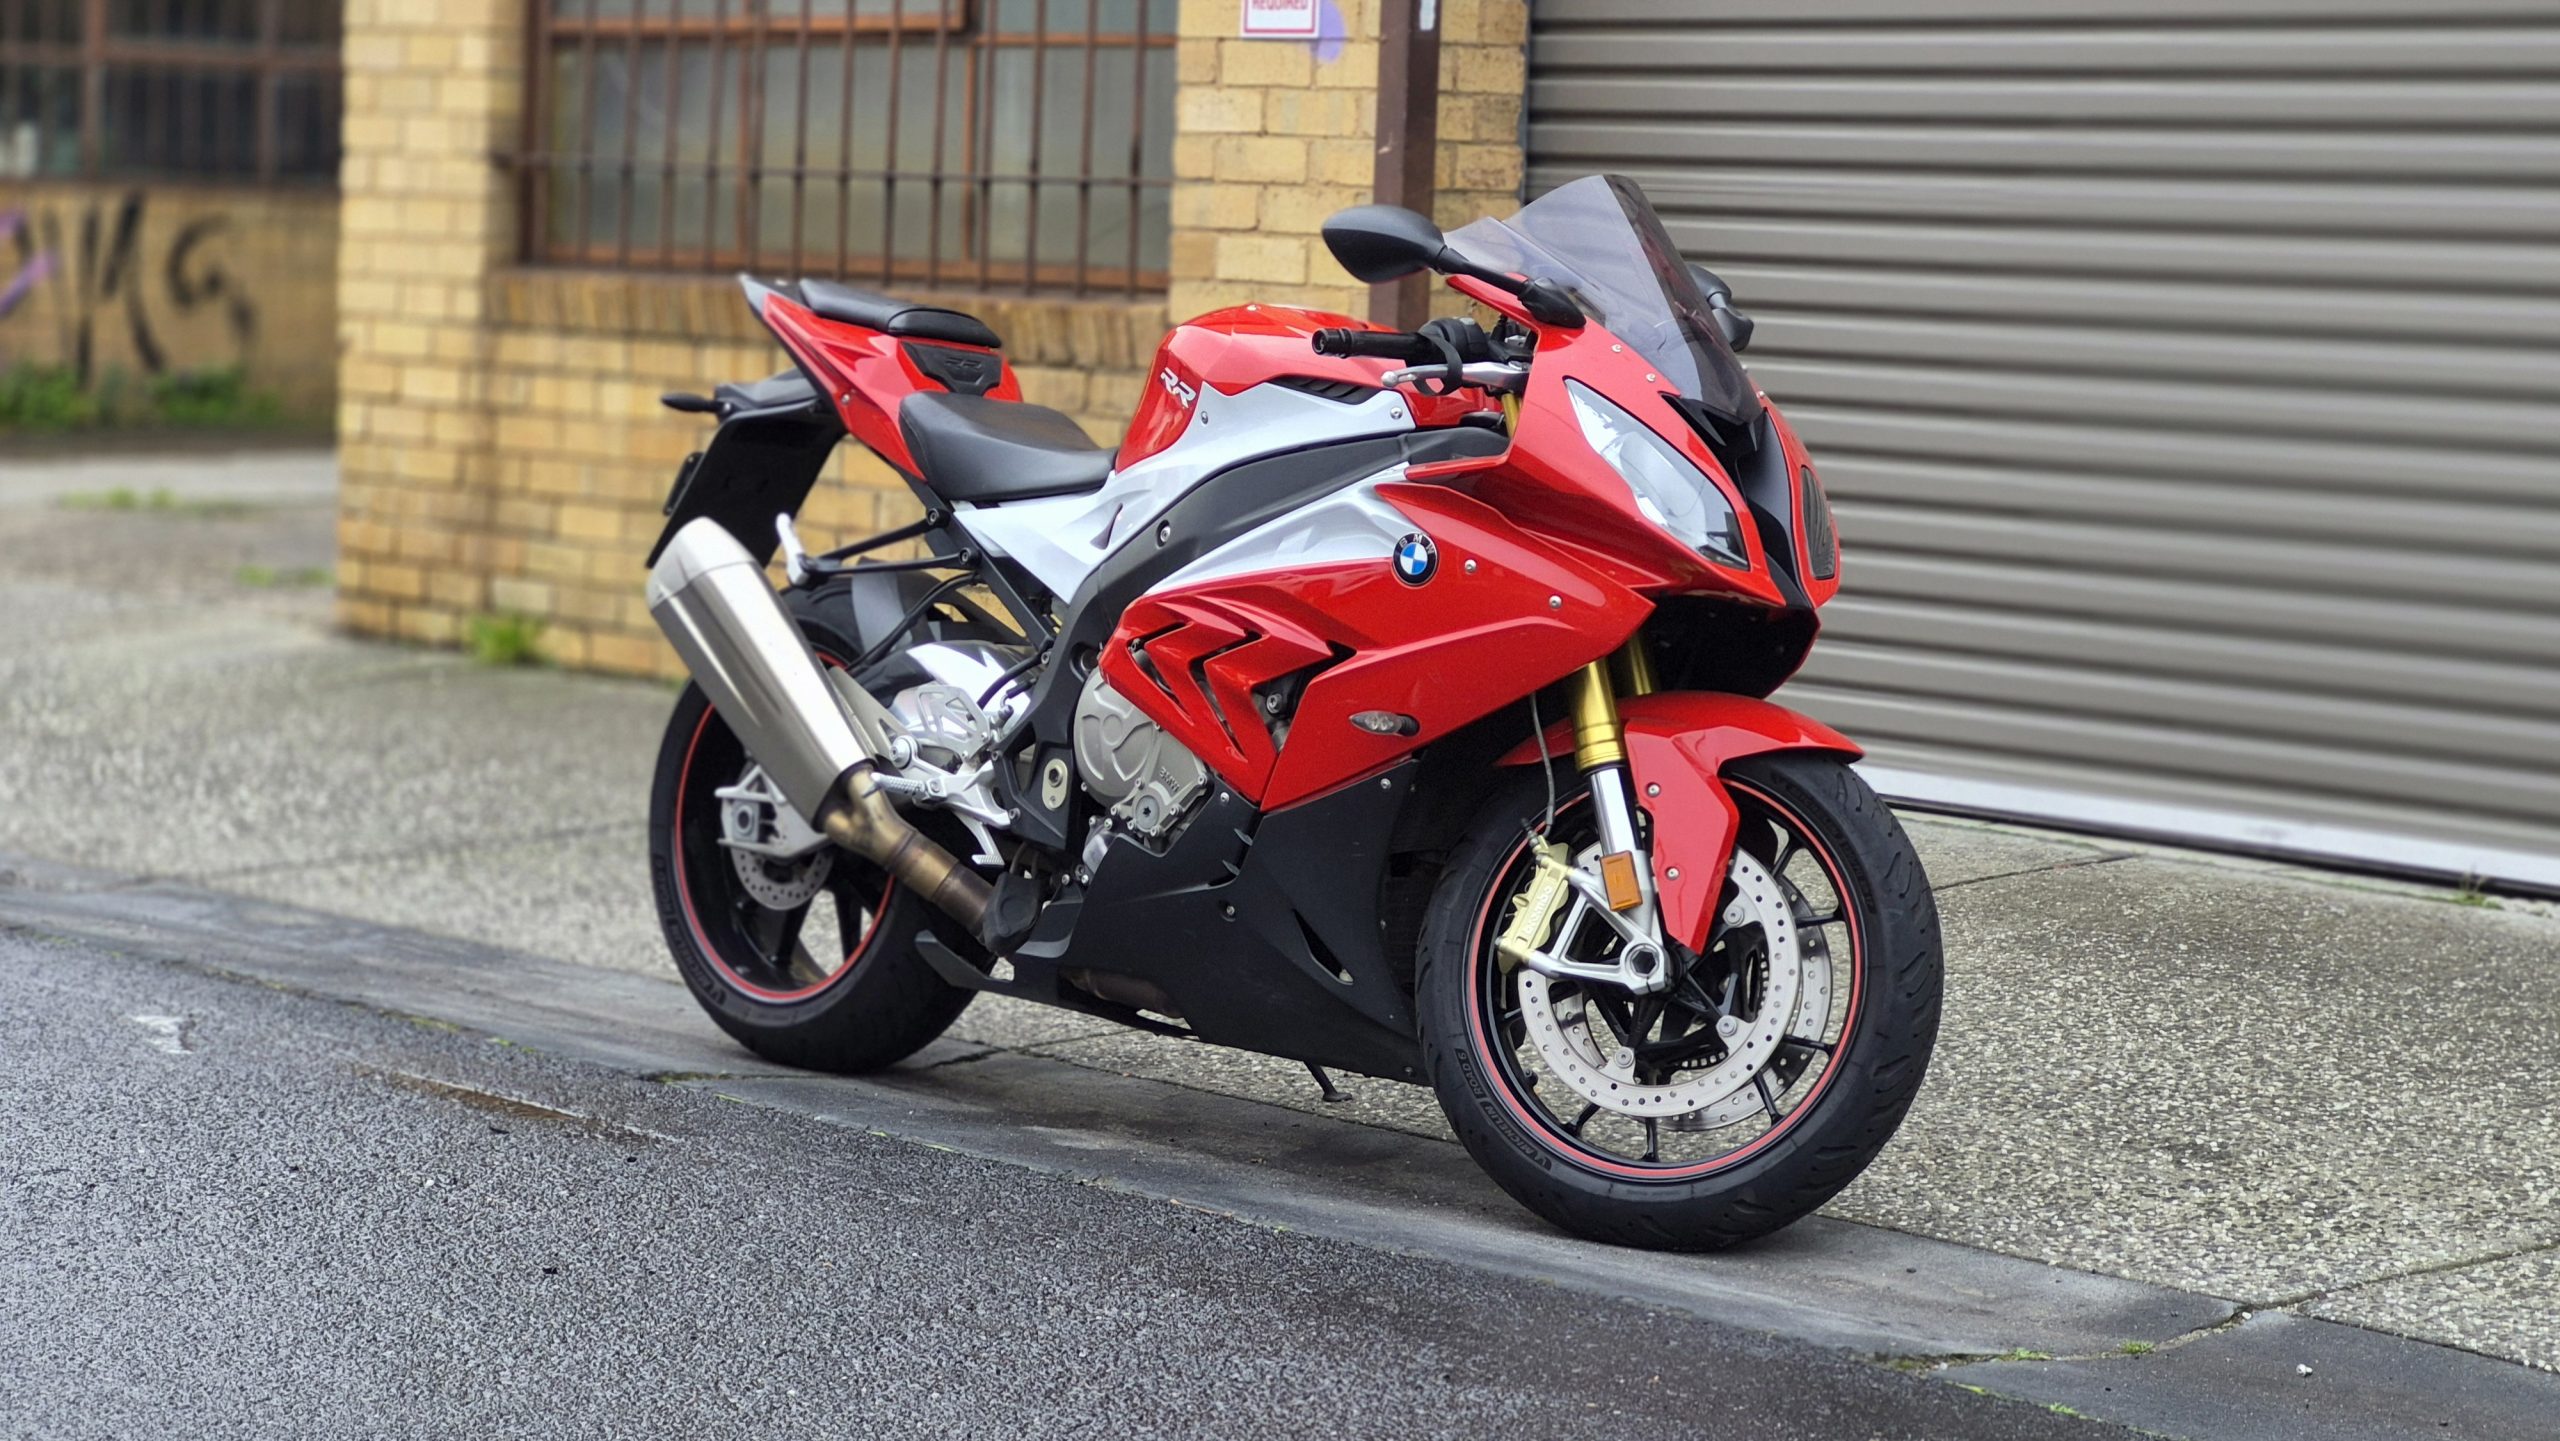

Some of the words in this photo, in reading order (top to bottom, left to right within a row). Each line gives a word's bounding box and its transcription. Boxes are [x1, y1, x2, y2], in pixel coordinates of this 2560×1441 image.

[1160, 366, 1196, 408] RR
[1462, 1063, 1484, 1096] ROAD
[1484, 1104, 1537, 1156] MICHELIN
